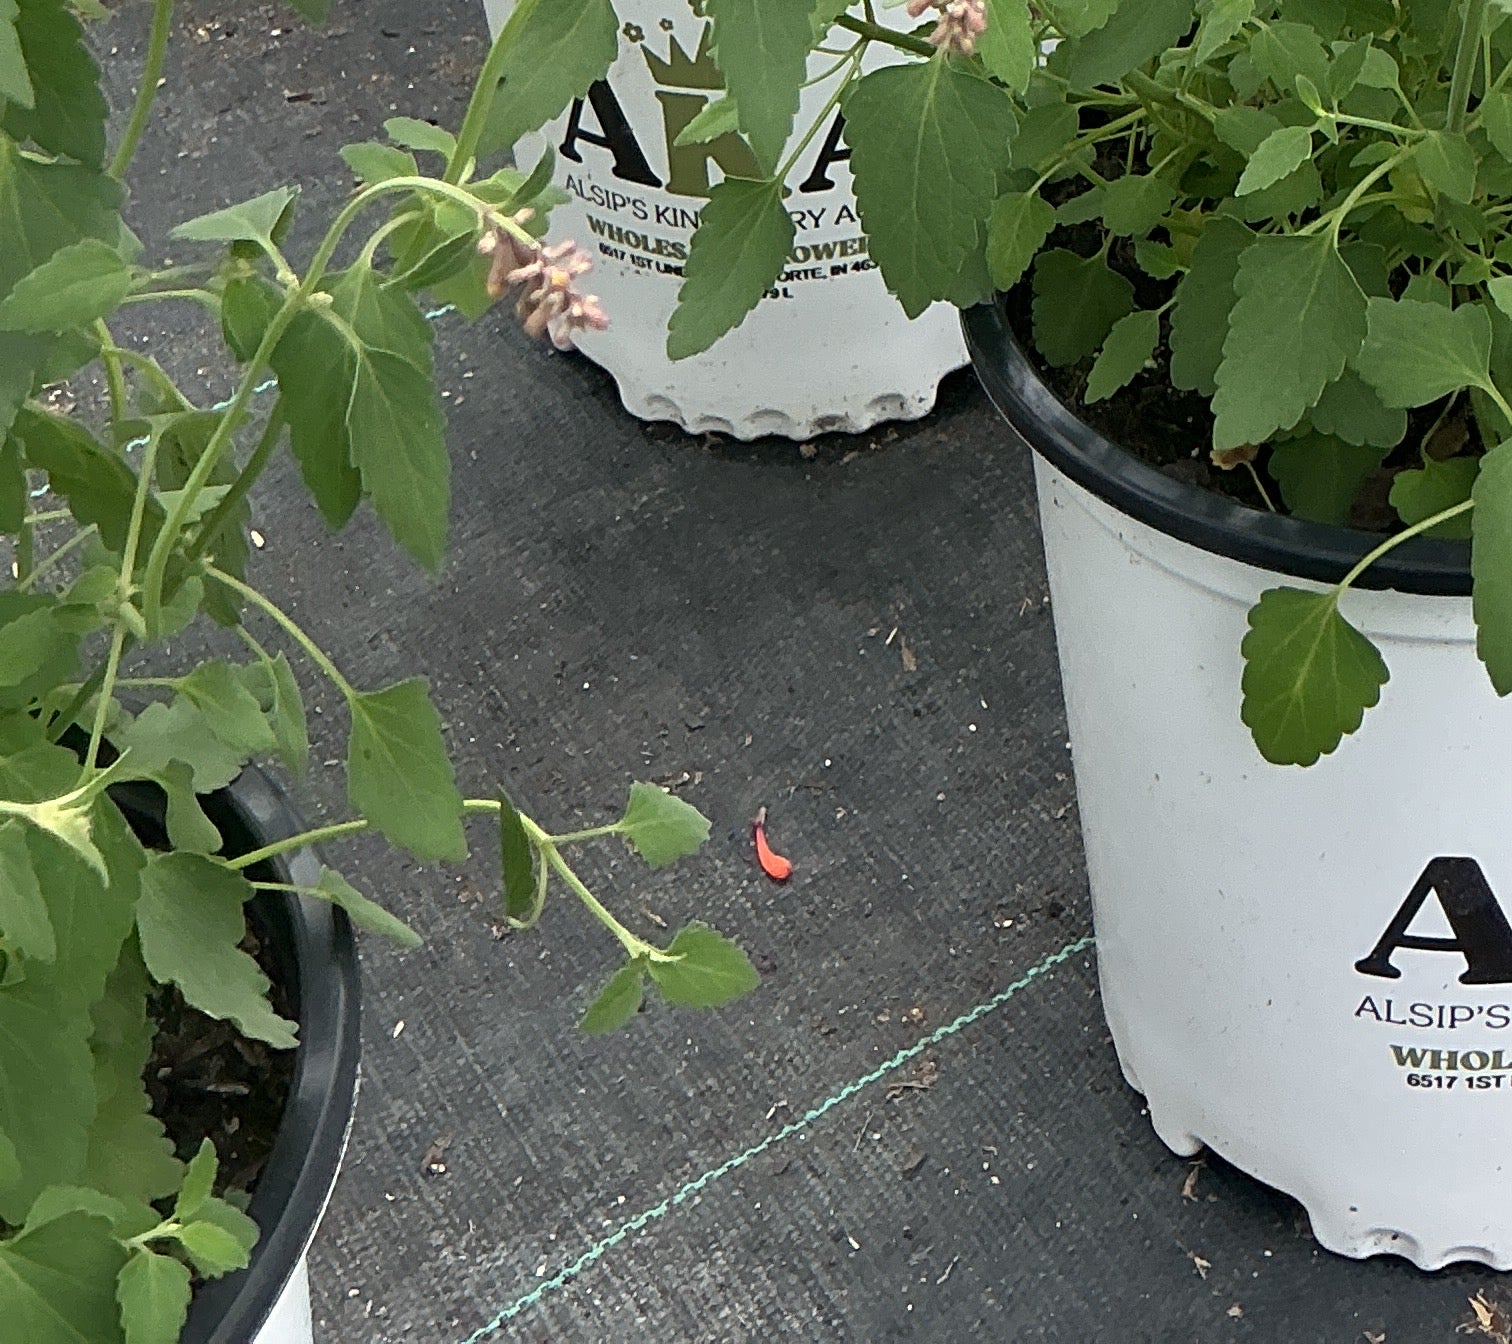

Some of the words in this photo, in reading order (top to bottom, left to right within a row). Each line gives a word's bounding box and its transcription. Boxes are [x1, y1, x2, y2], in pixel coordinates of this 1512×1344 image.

[566, 173, 649, 220] ALSIP'S
[586, 213, 687, 260] WHOLES
[1355, 995, 1511, 1029] ALSIP'S
[1406, 1073, 1458, 1089] 6517
[1465, 1074, 1506, 1089] 1ST
